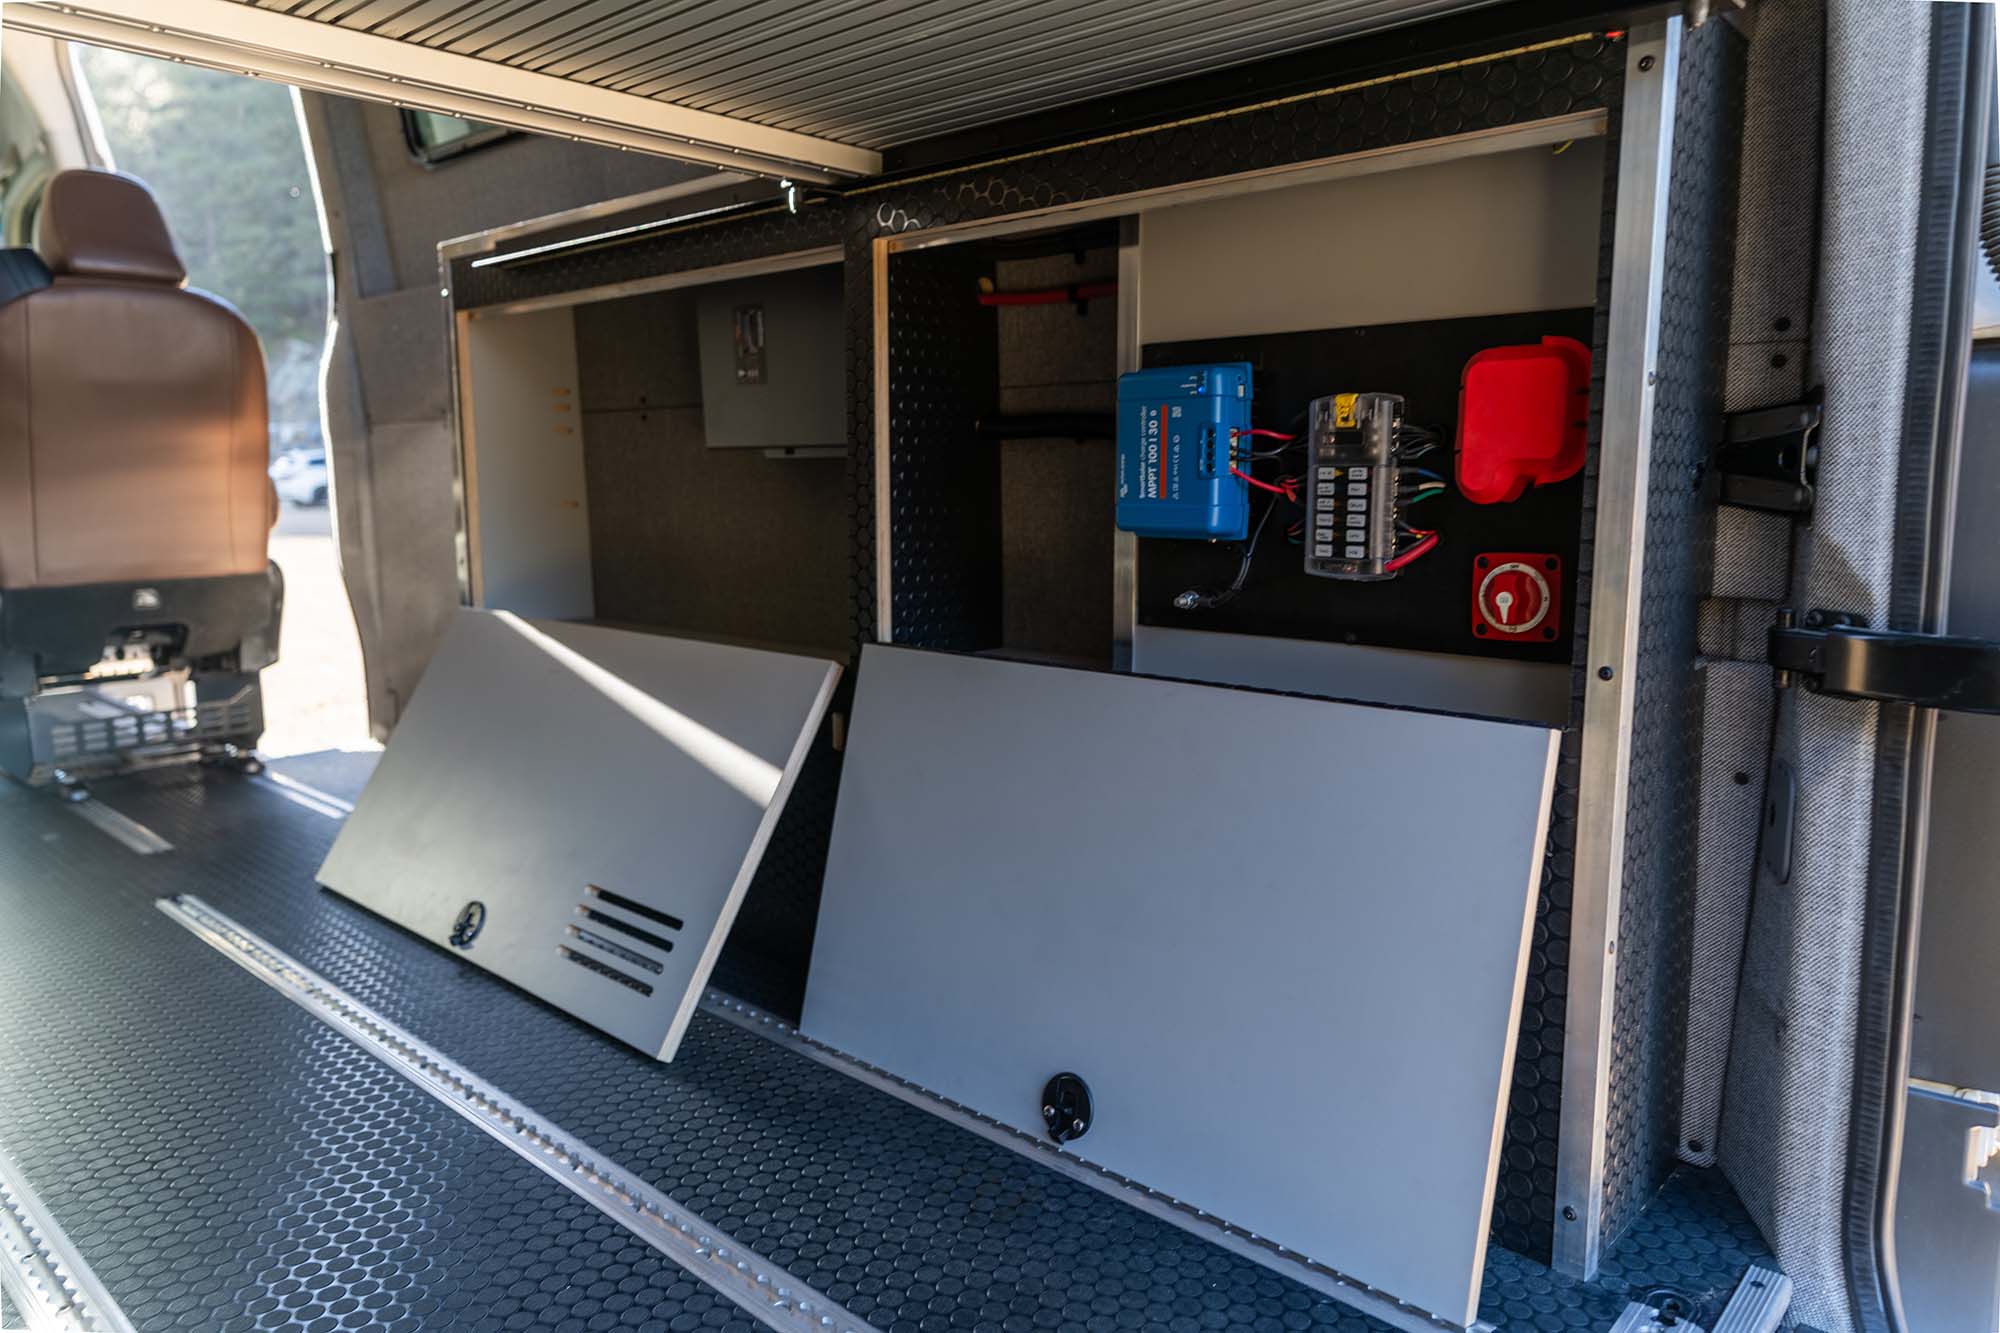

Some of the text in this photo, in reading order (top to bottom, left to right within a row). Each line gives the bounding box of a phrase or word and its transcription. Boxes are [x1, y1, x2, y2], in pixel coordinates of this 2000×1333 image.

[1148, 419, 1159, 435] 30
[1148, 444, 1158, 464] 100
[1148, 466, 1158, 499] MPPT
